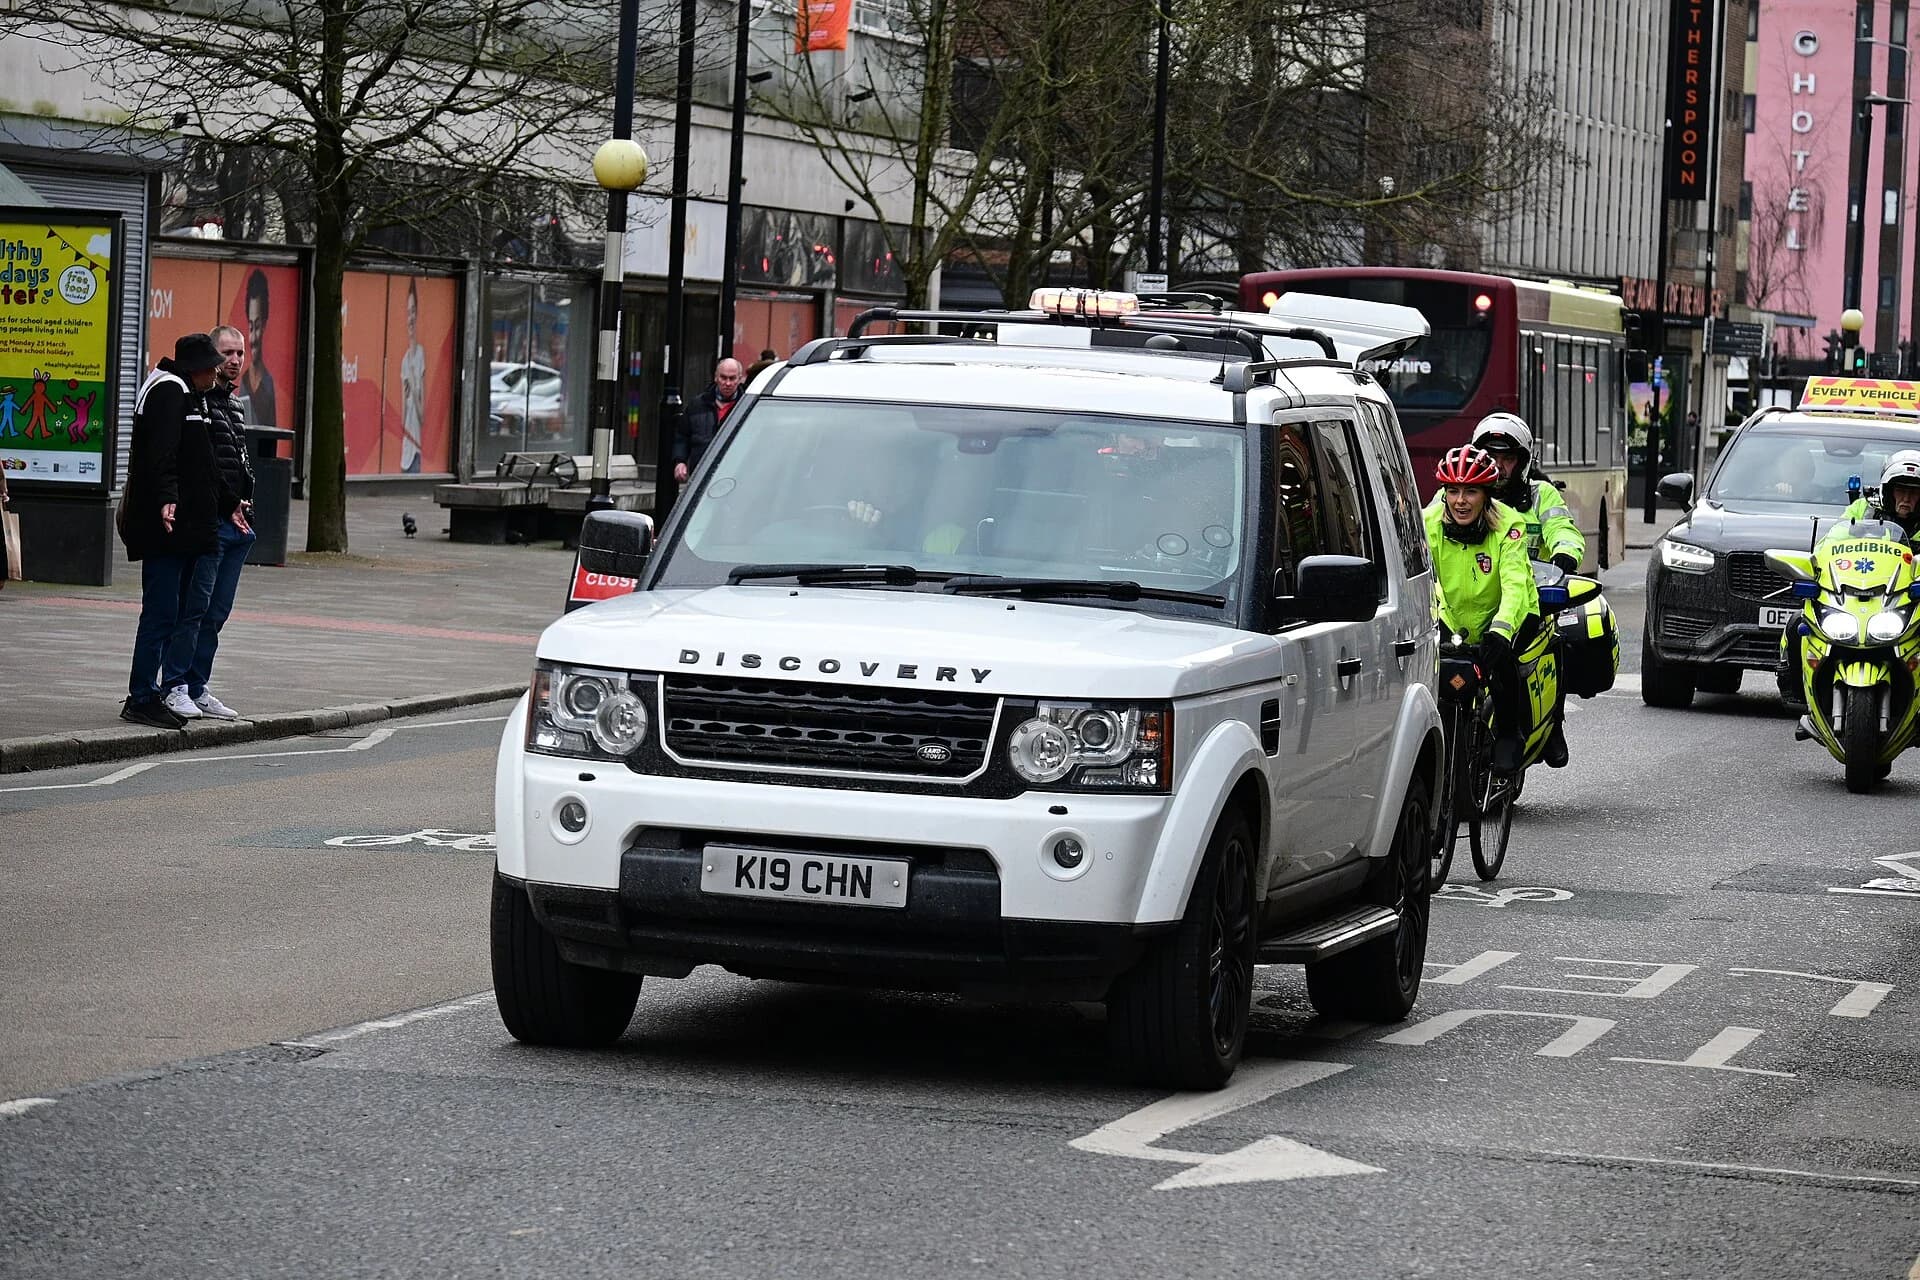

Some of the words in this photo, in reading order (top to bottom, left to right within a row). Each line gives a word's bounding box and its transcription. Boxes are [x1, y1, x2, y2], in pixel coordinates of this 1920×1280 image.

[1681, 0, 1701, 185] THERSPOON
[0, 262, 49, 288] days
[67, 271, 89, 285] free
[1, 284, 38, 305] ter
[64, 281, 90, 295] food
[7, 315, 18, 323] for
[20, 316, 42, 325] school
[44, 318, 62, 327] aged
[64, 318, 93, 327] children
[9, 326, 33, 334] people
[35, 326, 54, 335] living
[64, 327, 79, 335] Hull
[9, 339, 34, 347] Monday
[1811, 386, 1858, 397] EVENT
[1860, 388, 1917, 401] VEHICLE
[1831, 541, 1902, 558] MediBike
[678, 648, 993, 684] DISCOVERY
[734, 854, 792, 892] K19
[801, 859, 873, 899] CHN
